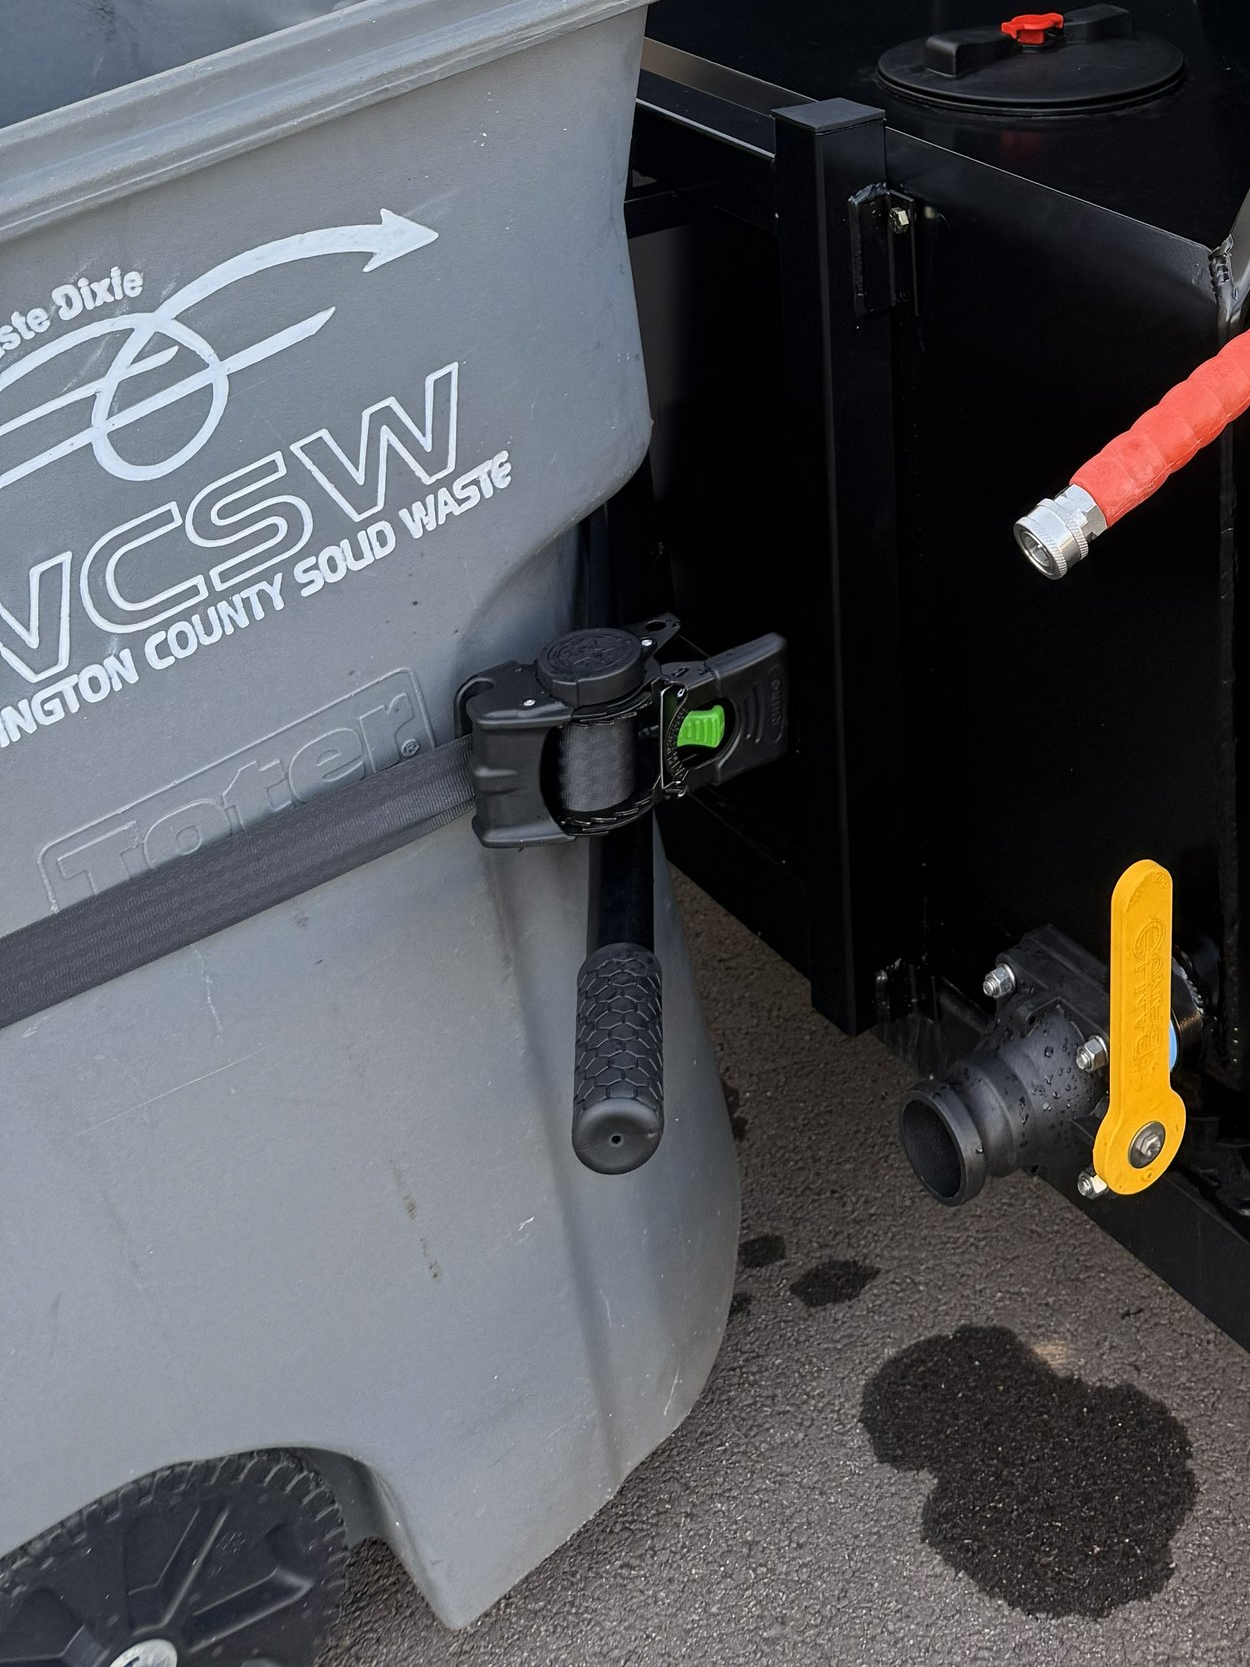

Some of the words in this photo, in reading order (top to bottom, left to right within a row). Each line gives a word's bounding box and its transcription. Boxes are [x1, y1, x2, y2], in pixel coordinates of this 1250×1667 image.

[51, 266, 144, 321] Dixie
[144, 572, 285, 670] COUNTY
[293, 521, 396, 597] SOLID
[398, 450, 512, 539] WASTE
